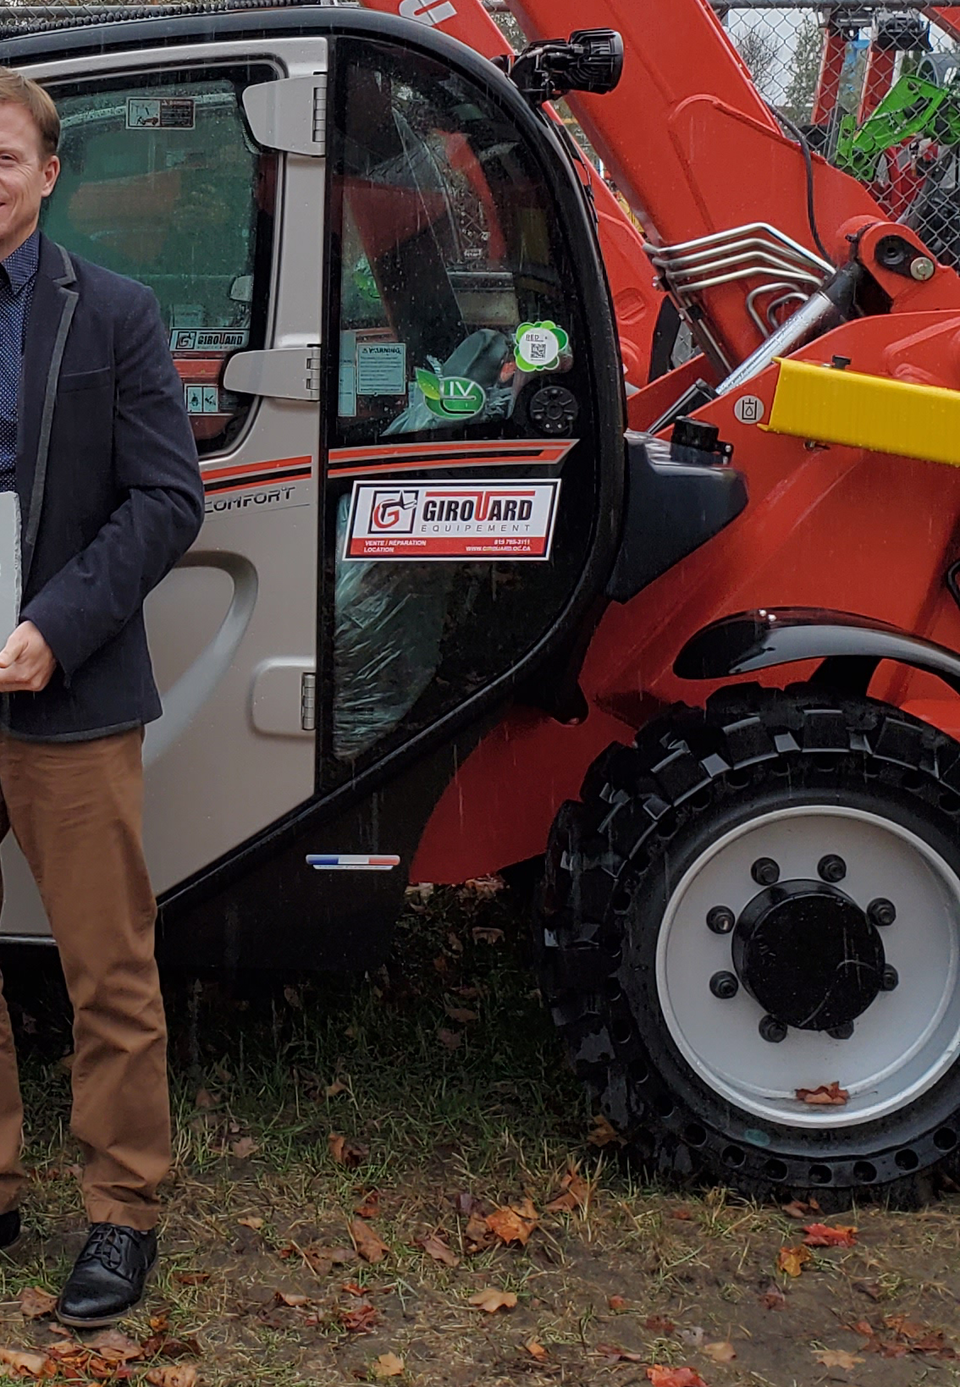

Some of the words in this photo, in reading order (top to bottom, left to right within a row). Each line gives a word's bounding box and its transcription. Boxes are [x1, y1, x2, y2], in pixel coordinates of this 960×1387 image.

[197, 334, 243, 346] GIROUARD
[422, 493, 533, 522] GIROUARD
[421, 524, 531, 532] EQUIPEMENT
